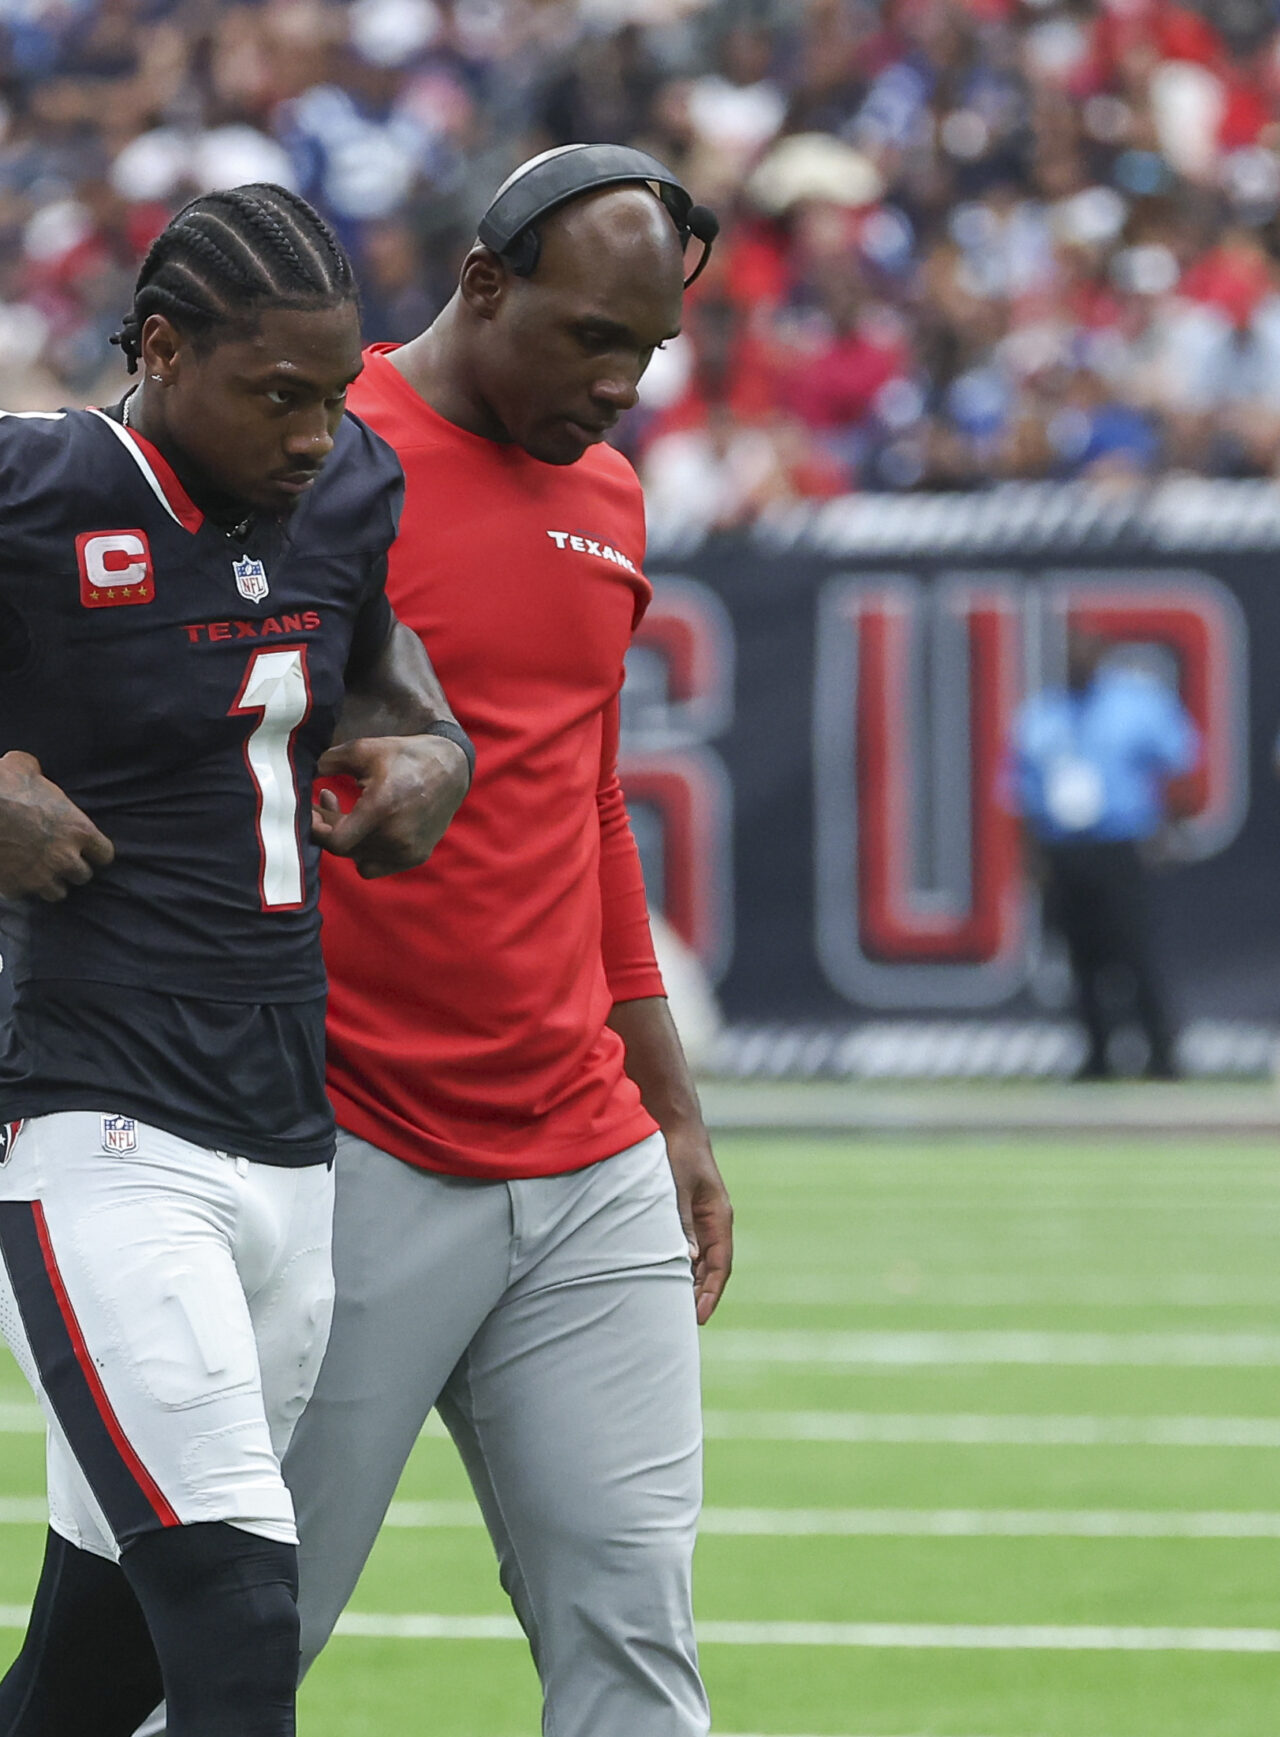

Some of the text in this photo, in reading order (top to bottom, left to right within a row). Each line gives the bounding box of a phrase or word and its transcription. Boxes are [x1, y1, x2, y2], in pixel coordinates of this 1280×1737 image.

[84, 534, 147, 588] C
[181, 610, 323, 643] TEXANS
[226, 642, 313, 912] 1
[814, 569, 1250, 1008] UP
